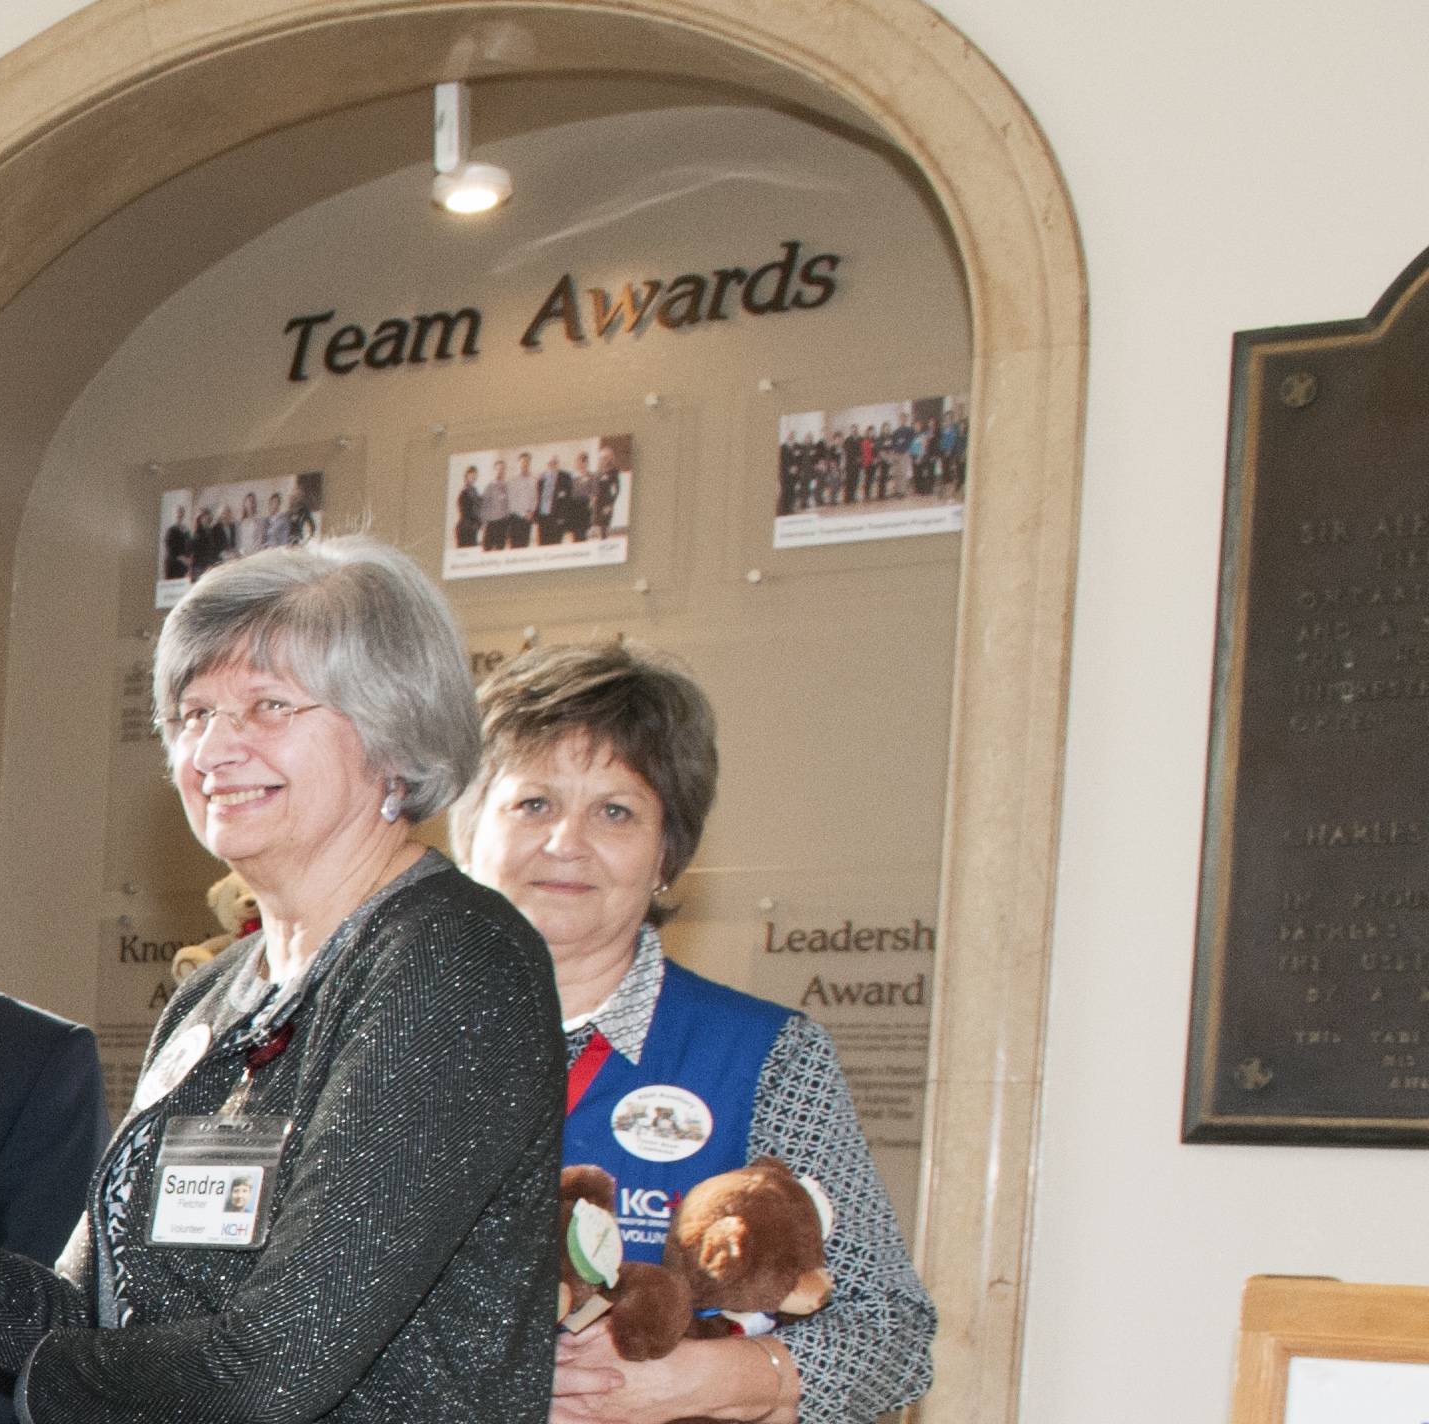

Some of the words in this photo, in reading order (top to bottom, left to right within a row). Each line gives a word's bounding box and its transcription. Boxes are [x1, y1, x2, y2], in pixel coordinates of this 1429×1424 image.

[284, 306, 483, 382] Team
[520, 241, 841, 348] Awards
[765, 918, 937, 954] Leadersh
[800, 972, 926, 1007] Award
[164, 1174, 226, 1196] Sandra
